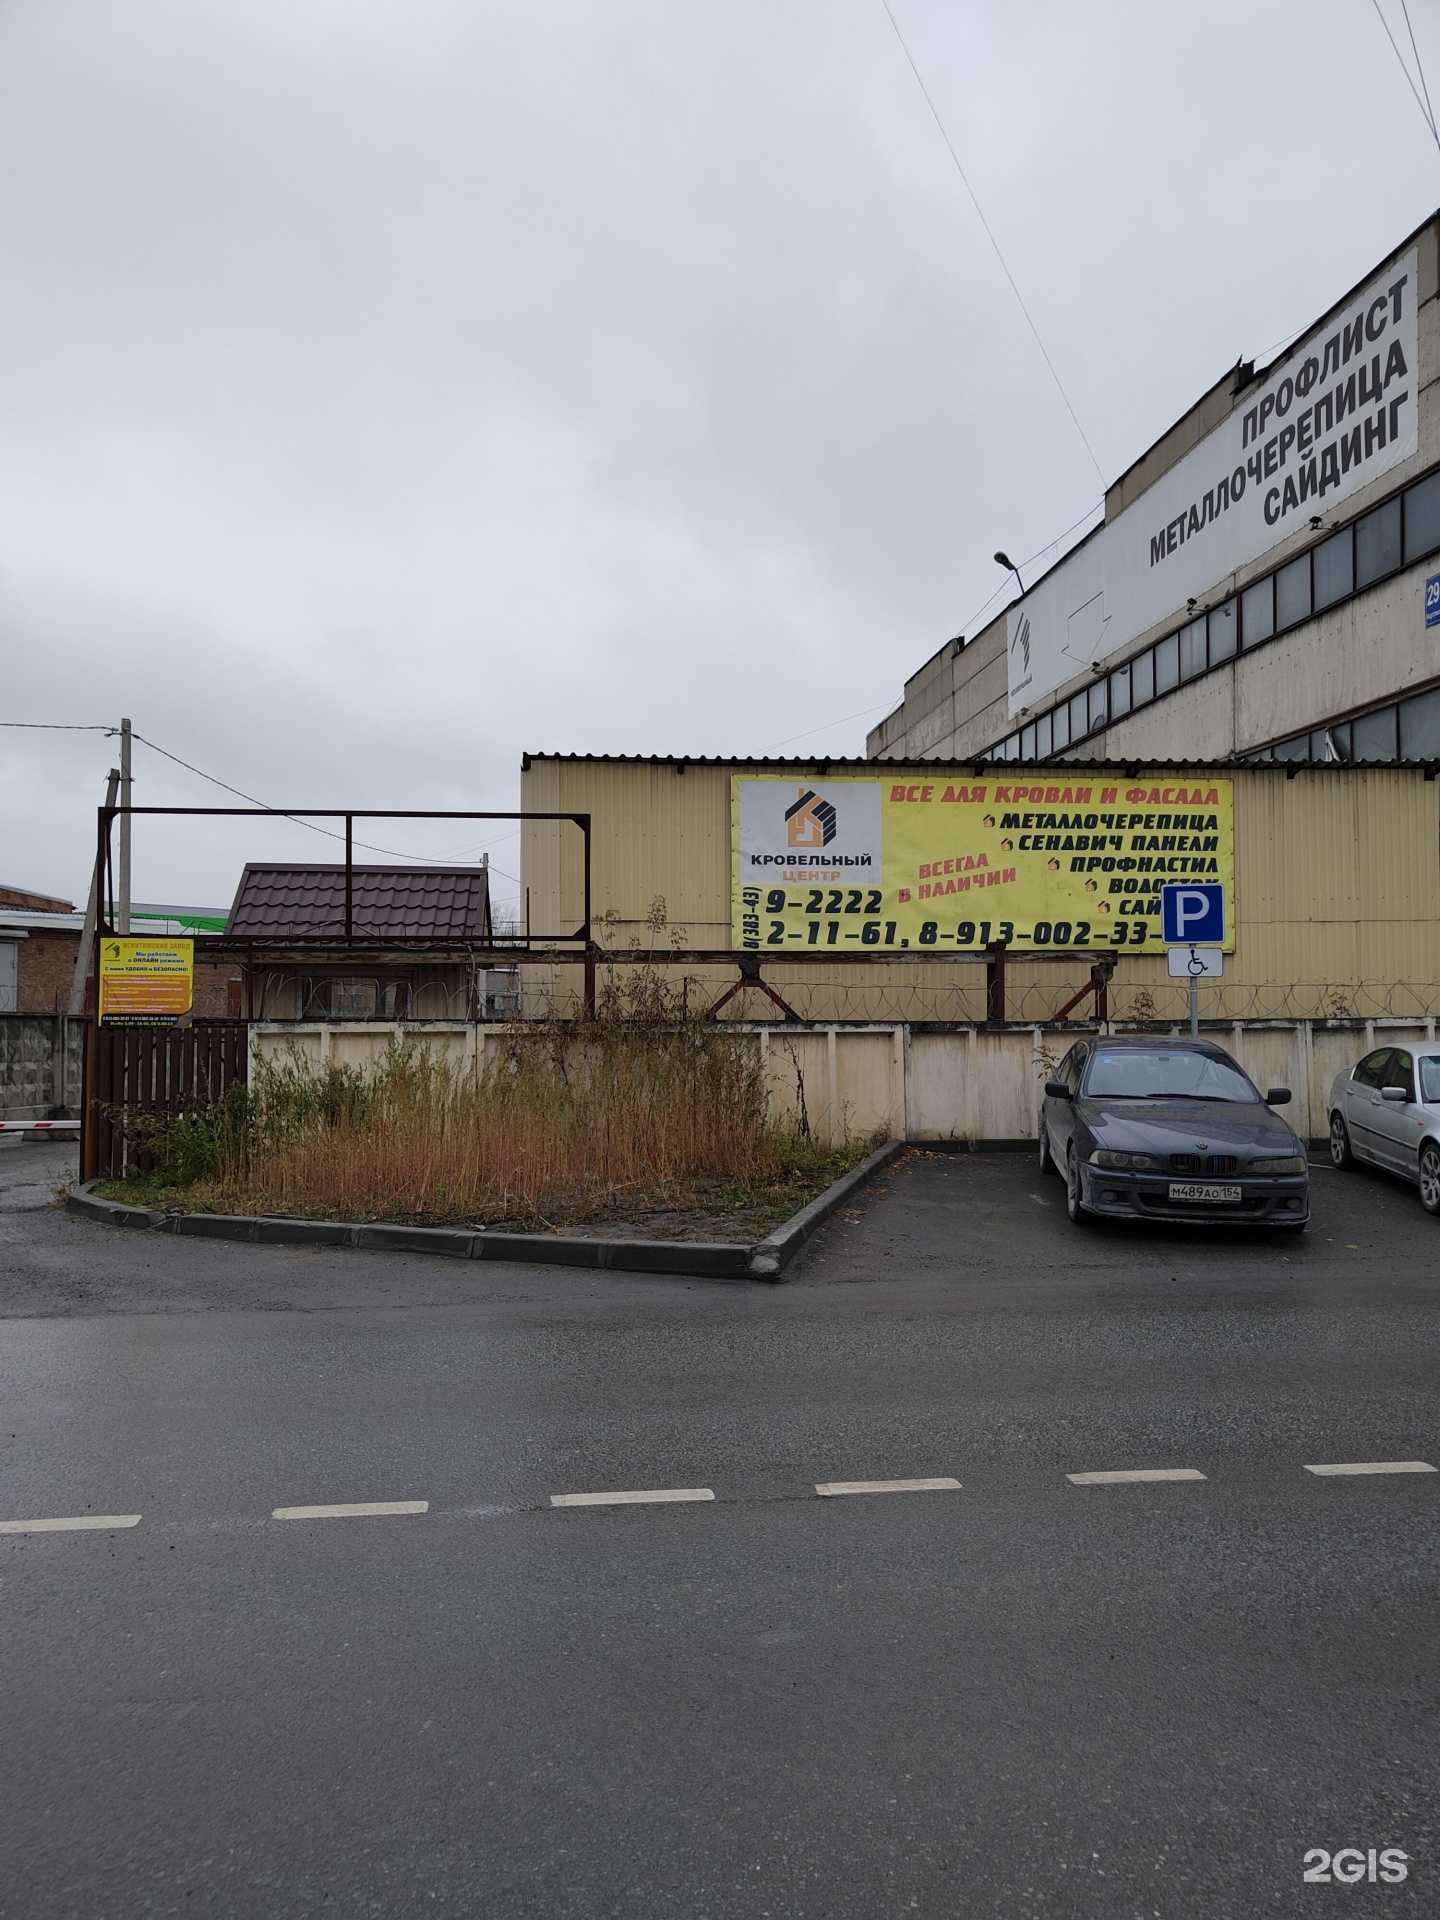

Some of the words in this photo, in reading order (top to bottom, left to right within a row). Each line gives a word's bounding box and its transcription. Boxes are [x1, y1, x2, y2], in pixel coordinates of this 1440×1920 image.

[1241, 273, 1408, 450] ПРОФЛИСТ
[1149, 338, 1409, 568] МЕТАЛЛОЧЕРЕПИЦА
[1263, 390, 1409, 526] САЙДИНГ
[889, 784, 934, 803] ВСЕ
[940, 784, 988, 803] ДЛЯ
[994, 786, 1093, 804] КРОВЛИ
[1100, 787, 1118, 804] И
[1125, 787, 1220, 805] ФАСАДА
[999, 813, 1218, 832] МЕТАЛЛОЧЕРЕПИЦА
[1018, 834, 1123, 851] СЕНДВИЧ
[1130, 835, 1219, 852] ПАНЕЛИ
[751, 853, 872, 866] КРОВЕЛЬНЫЙ
[918, 853, 989, 880] ВСЕГДА
[1069, 856, 1219, 873] ПРОФНАСТИЛ
[782, 870, 841, 883] ЦЕНТР
[898, 888, 911, 904] В
[918, 867, 1017, 900] НАЛИЧИИ
[765, 889, 883, 914] 9-2222
[766, 921, 909, 948] 2-11-61,
